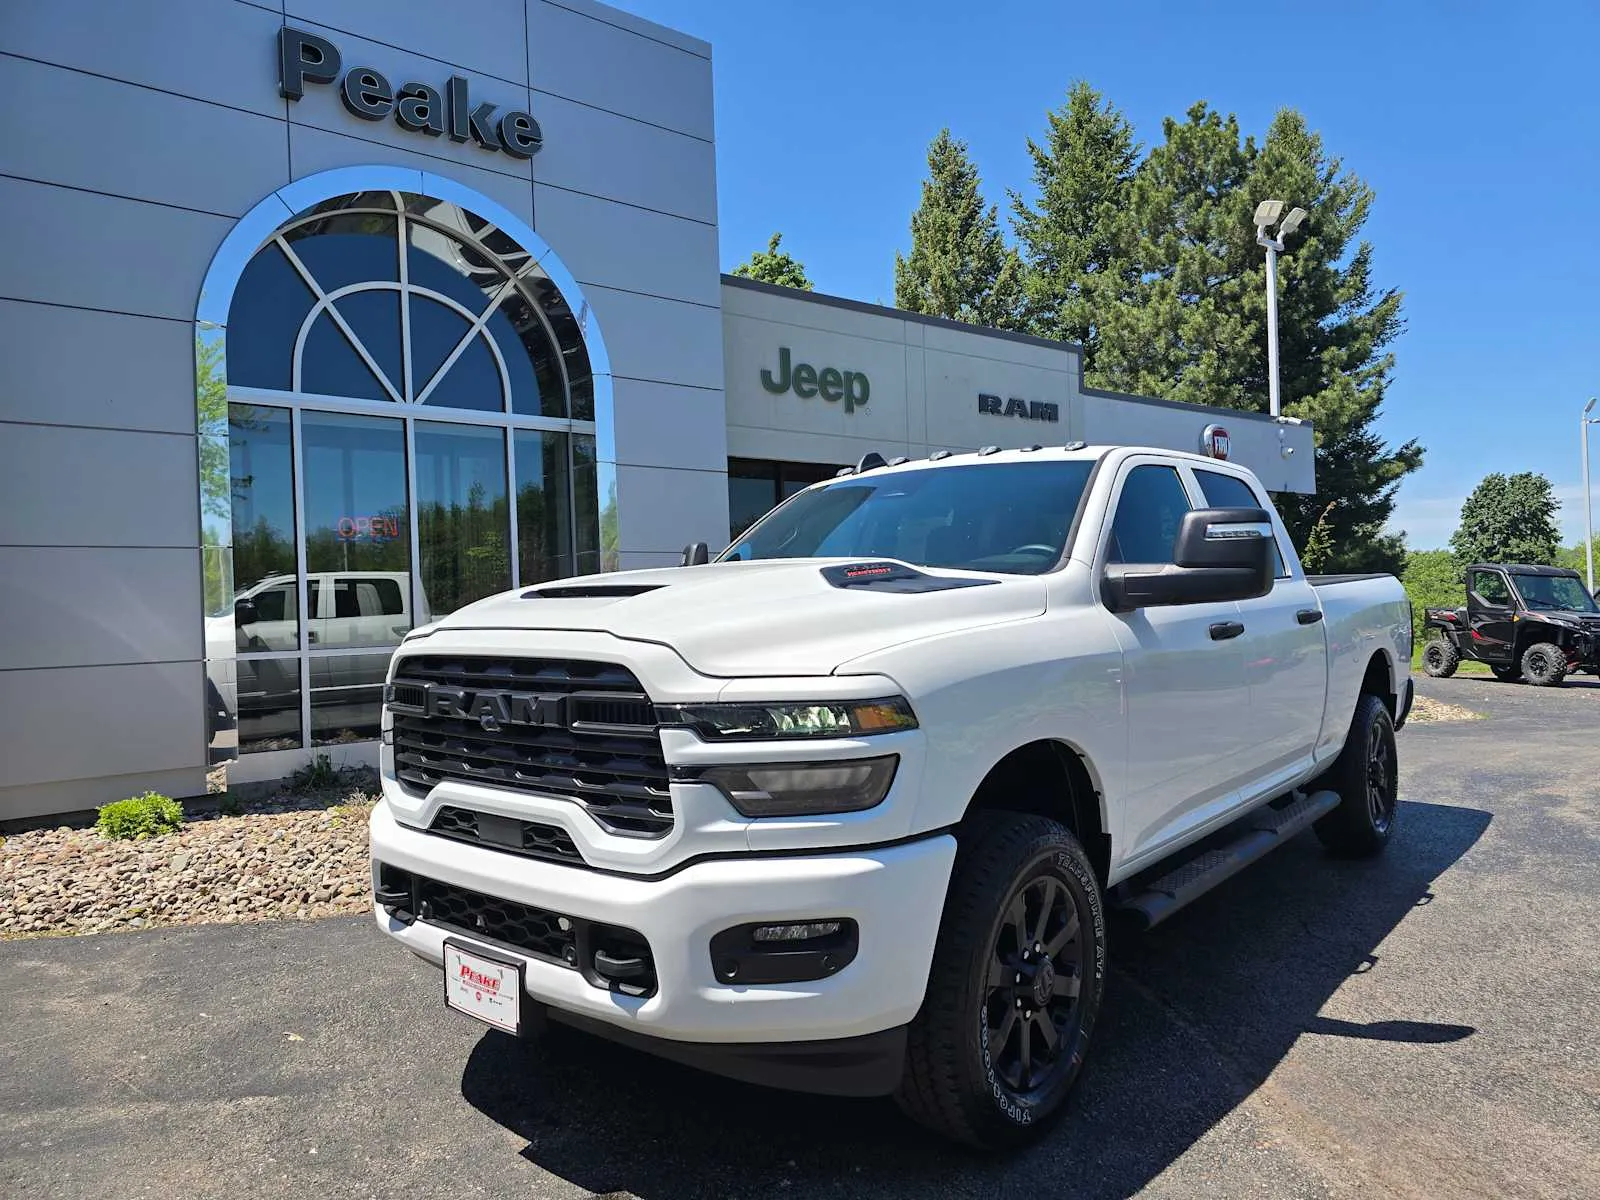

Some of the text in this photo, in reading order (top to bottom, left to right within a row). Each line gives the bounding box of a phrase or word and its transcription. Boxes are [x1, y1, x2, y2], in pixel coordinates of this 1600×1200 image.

[277, 25, 543, 159] Peake
[760, 347, 870, 414] Jeep
[978, 393, 1059, 422] RAM
[339, 515, 397, 537] OPEN
[428, 685, 567, 728] RAM
[460, 964, 501, 989] PEAKE
